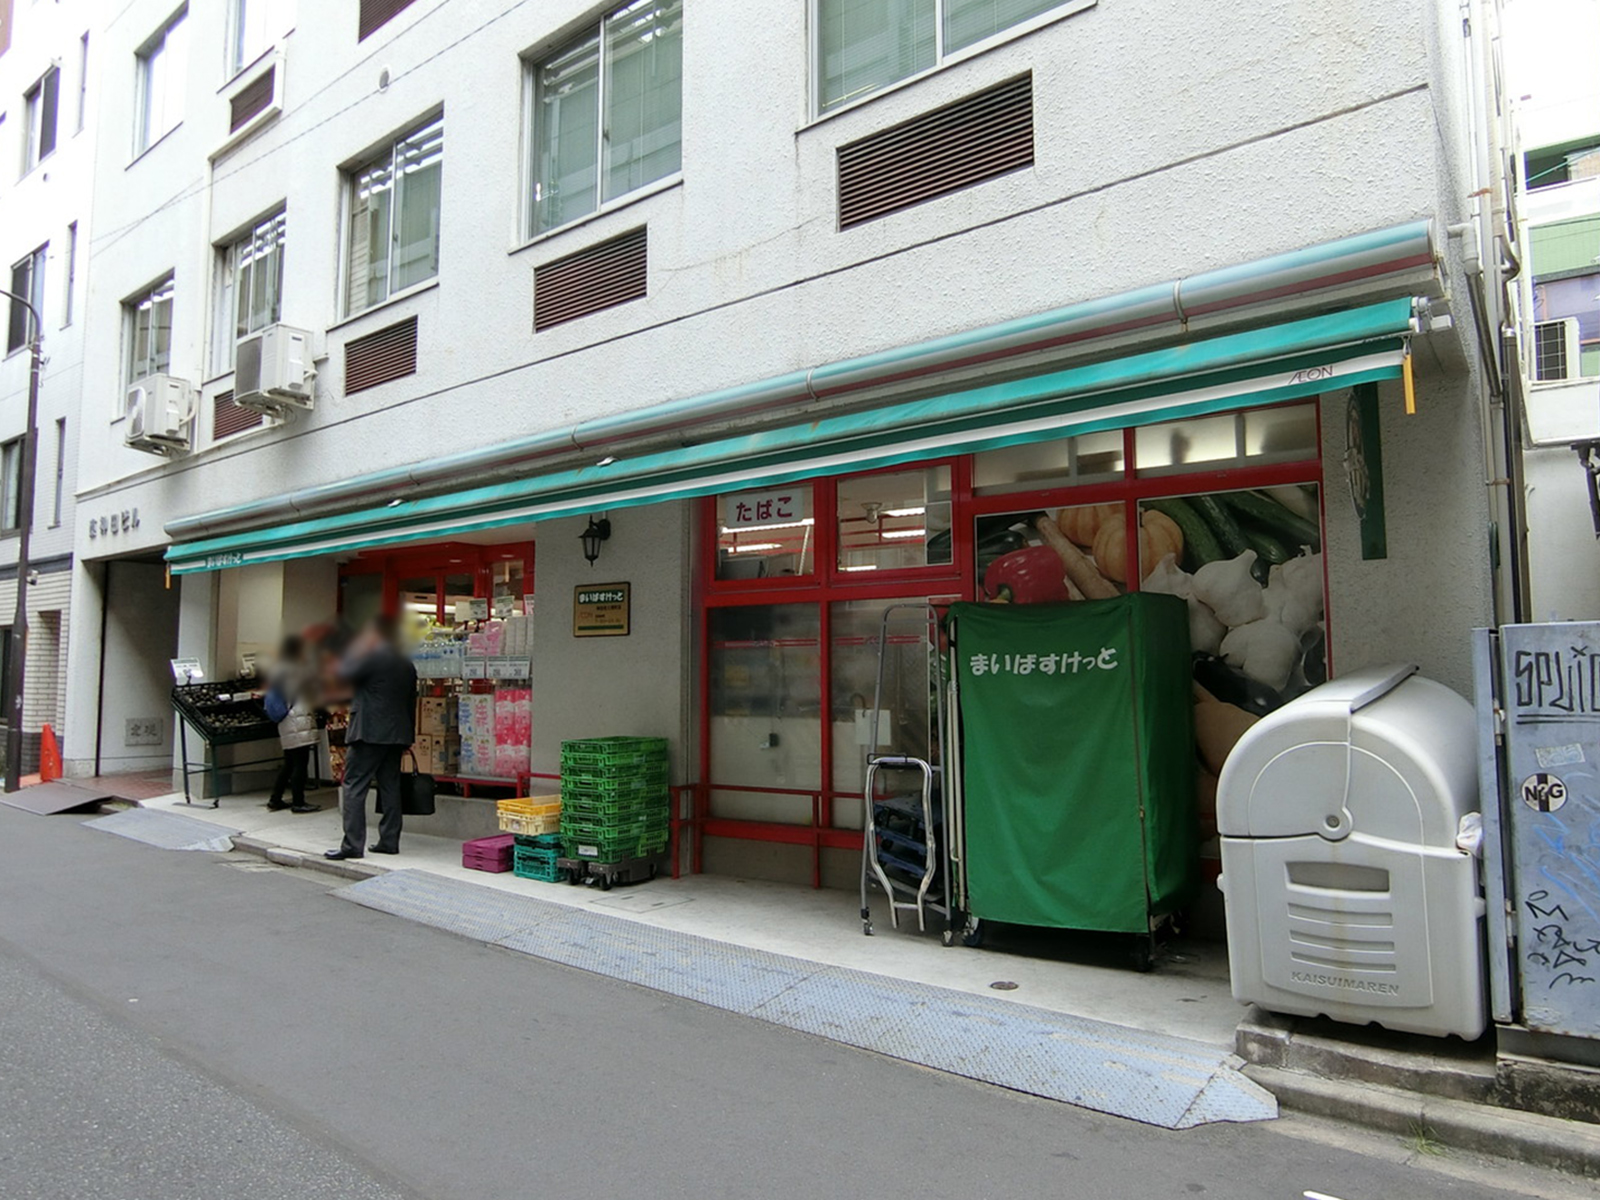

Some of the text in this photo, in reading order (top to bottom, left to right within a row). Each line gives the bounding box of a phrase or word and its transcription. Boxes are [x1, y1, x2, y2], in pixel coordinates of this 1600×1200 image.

[736, 496, 793, 522] たばこ
[579, 591, 624, 603] まいばすけっと
[969, 646, 1119, 676] まいばすけっと
[1290, 970, 1400, 997] KAISUIMAREN
